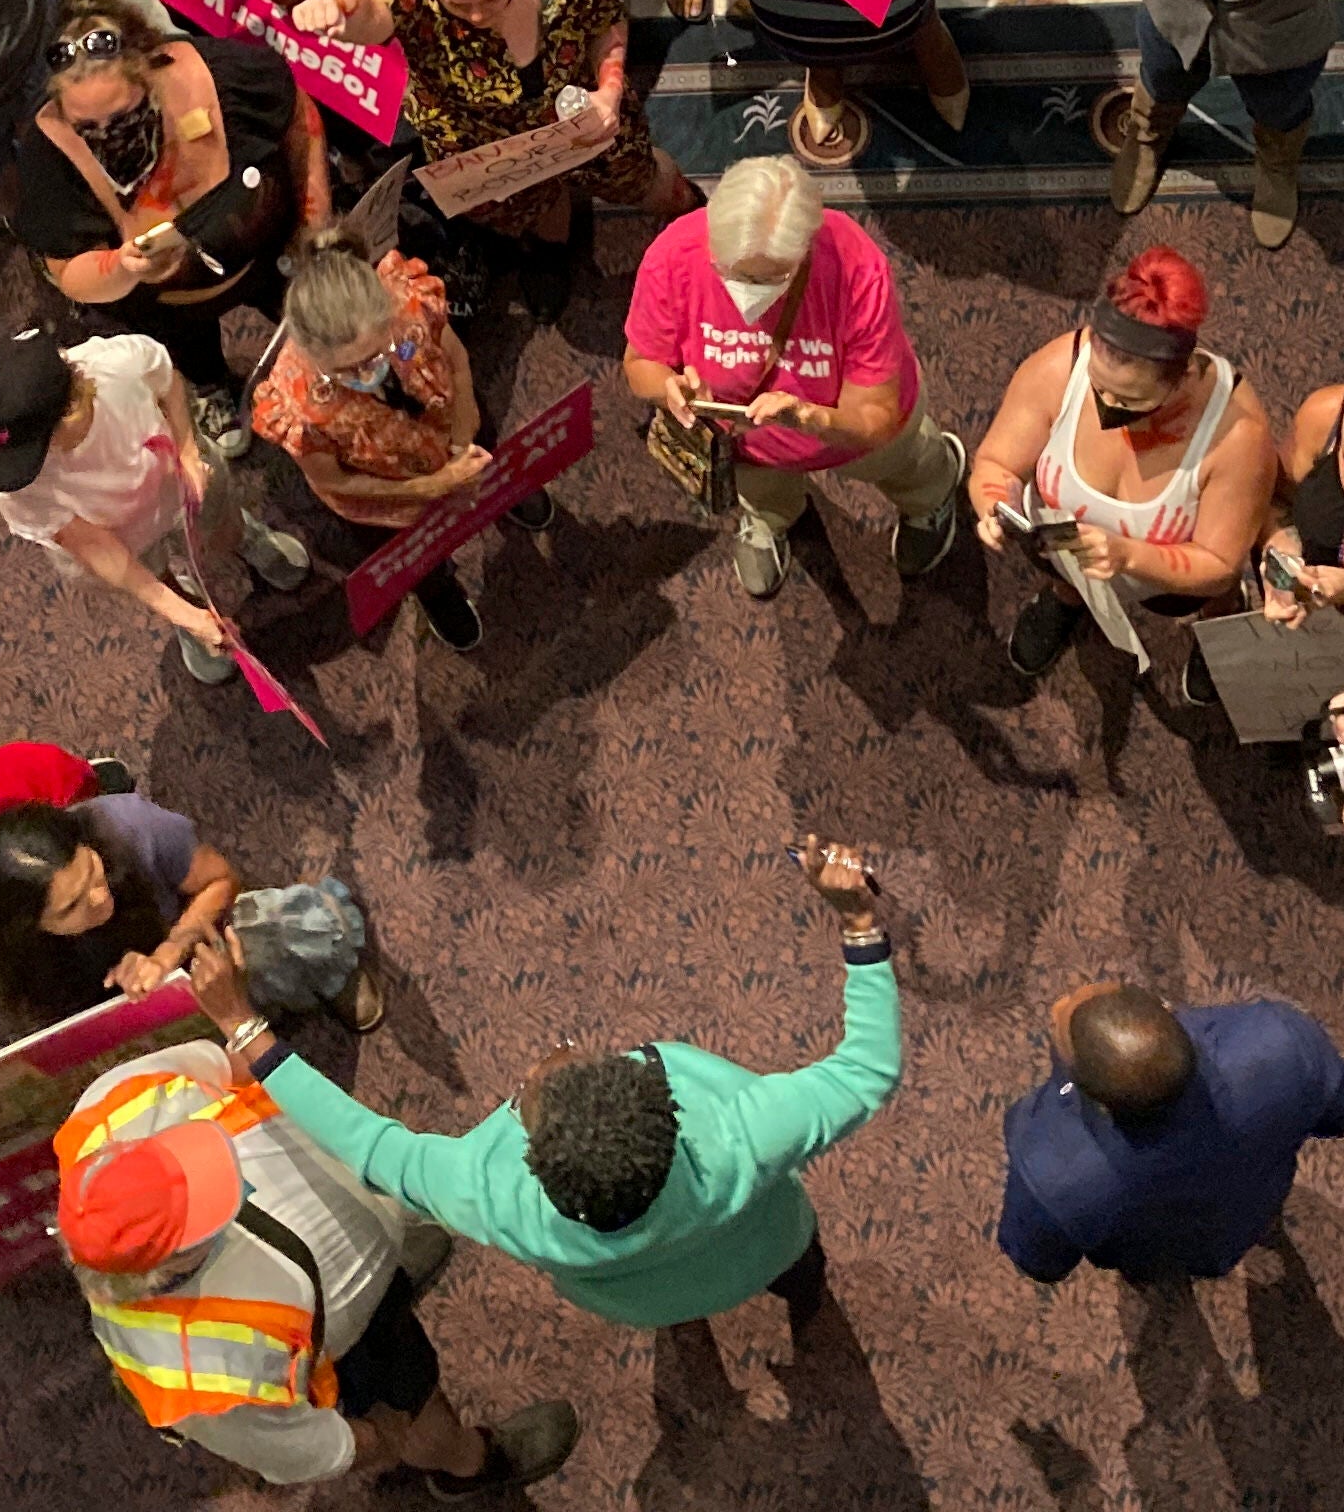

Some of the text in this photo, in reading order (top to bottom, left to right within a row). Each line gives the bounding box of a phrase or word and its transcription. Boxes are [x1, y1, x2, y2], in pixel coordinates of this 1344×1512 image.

[232, 6, 381, 116] Together
[704, 344, 830, 377] Fight All
[799, 338, 833, 356] We
